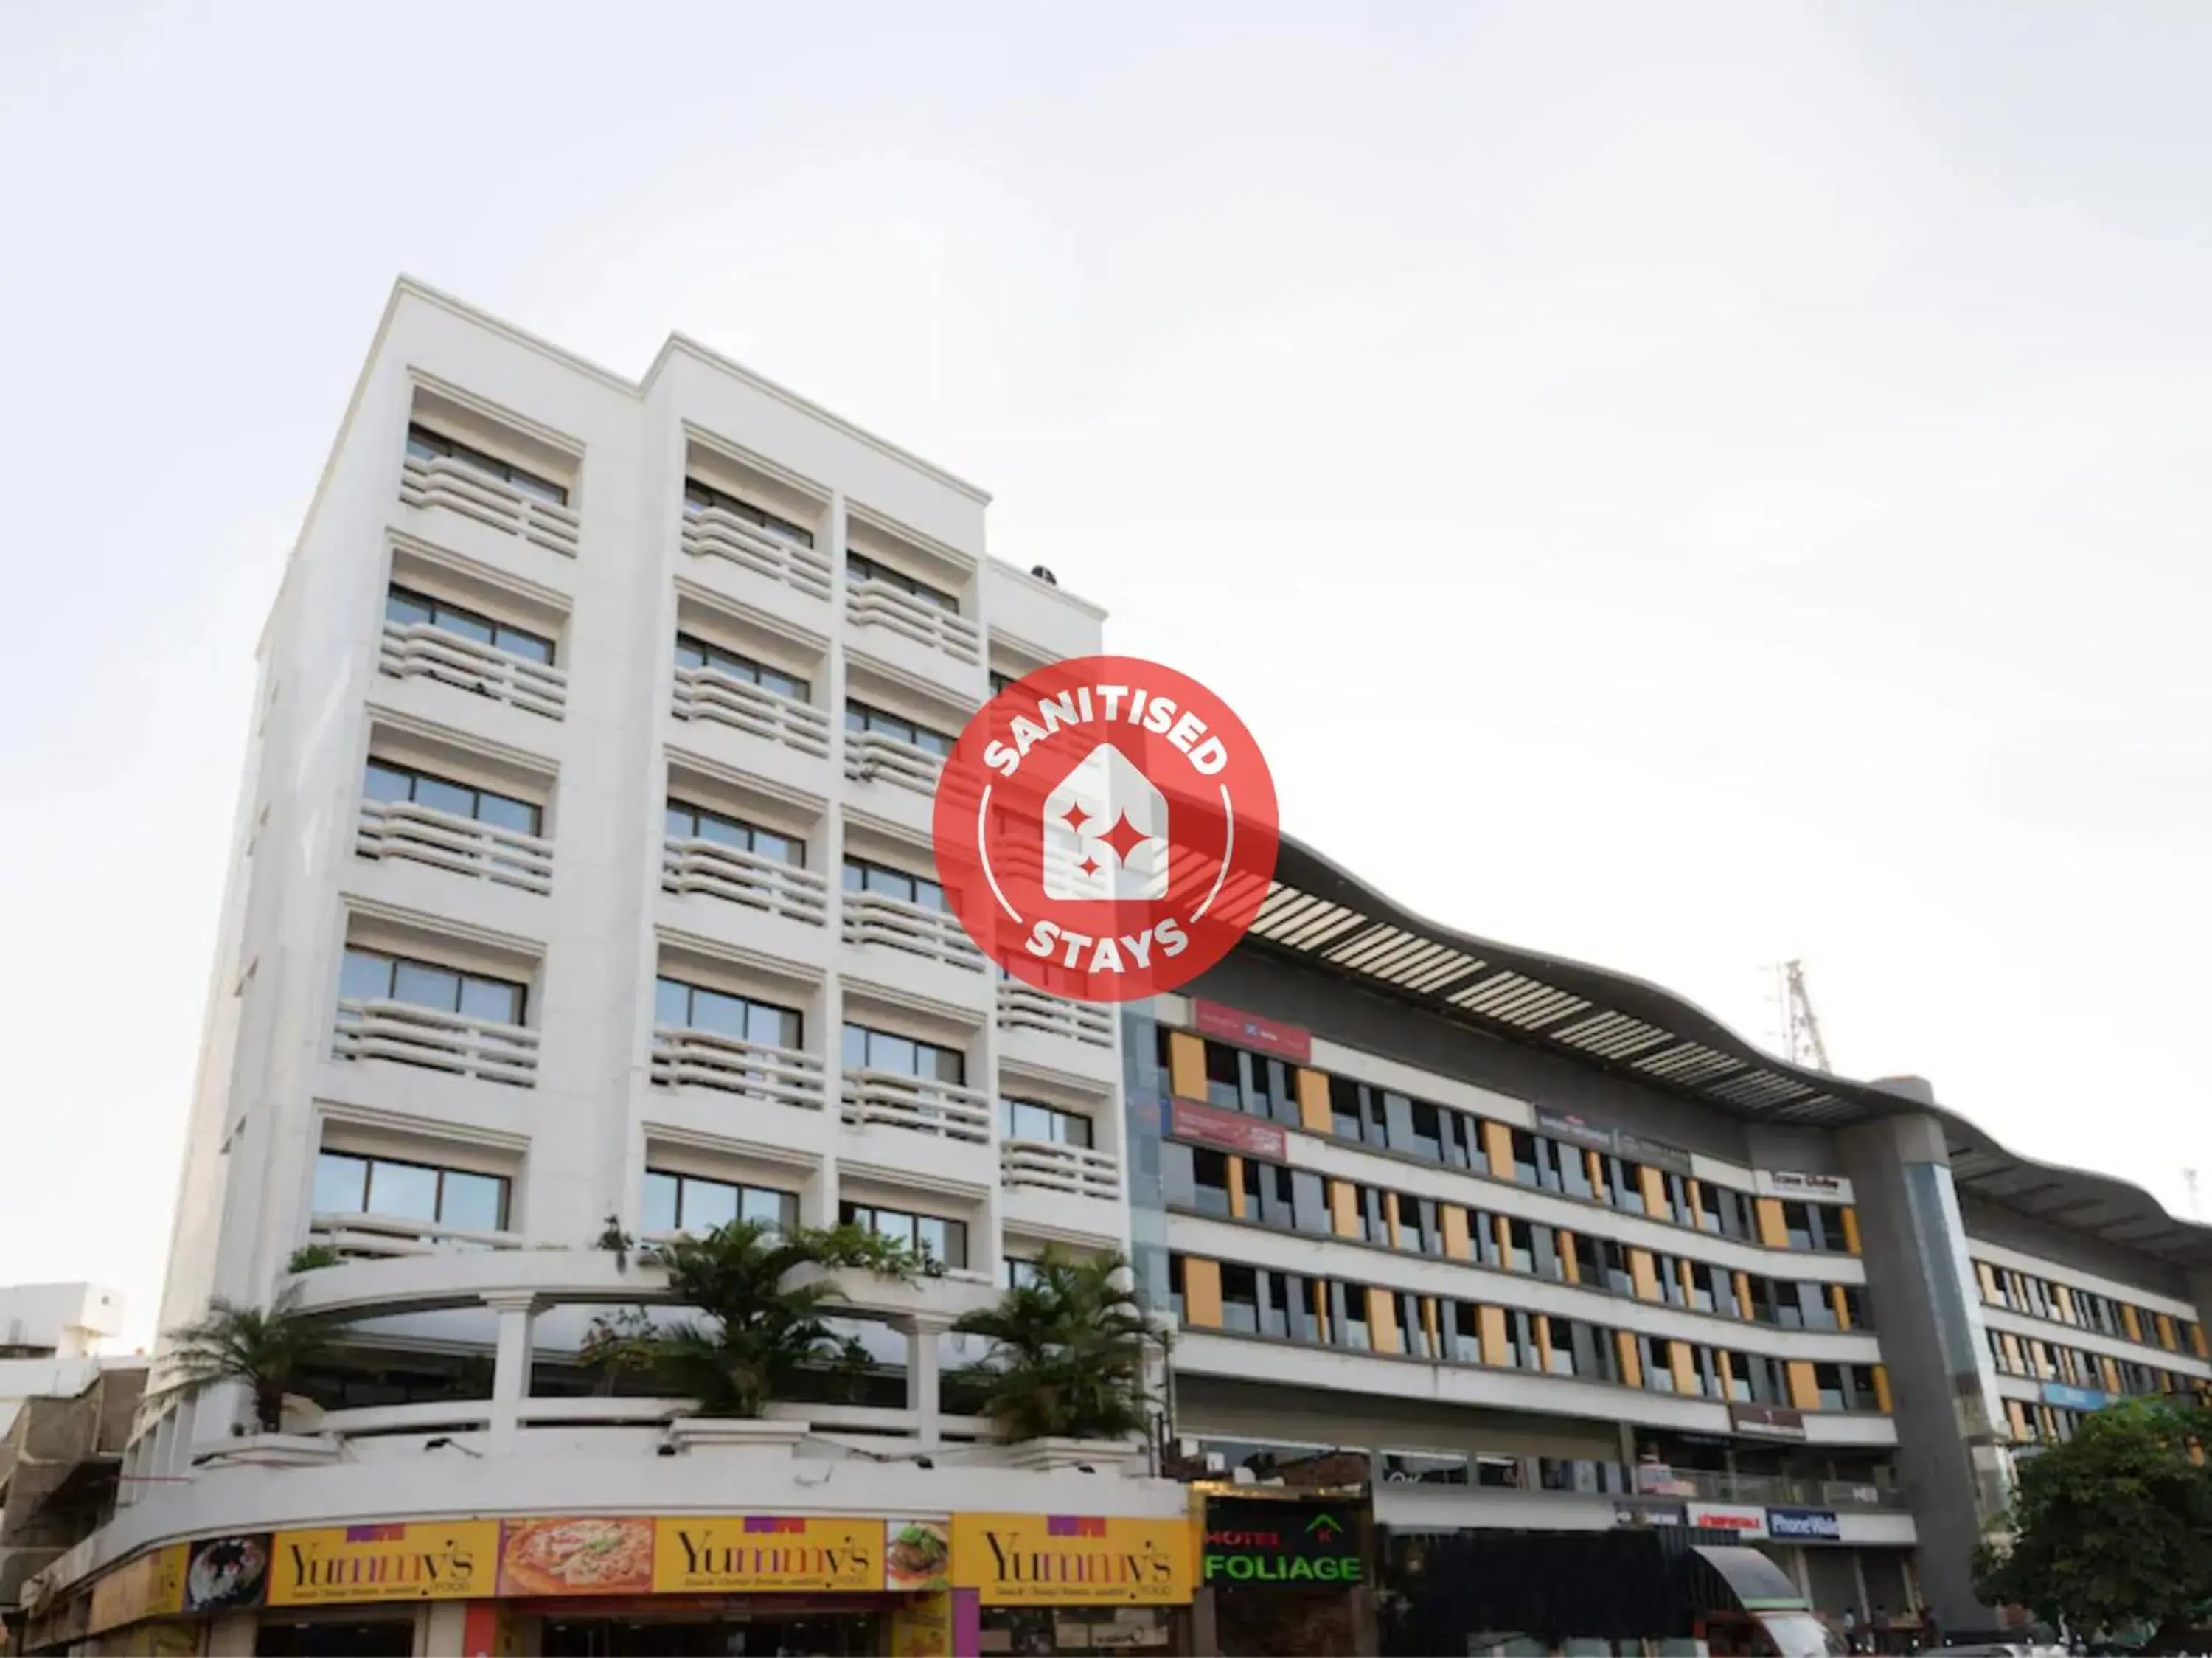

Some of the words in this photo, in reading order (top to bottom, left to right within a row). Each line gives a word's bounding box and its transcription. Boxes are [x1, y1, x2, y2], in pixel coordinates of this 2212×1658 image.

[288, 1539, 473, 1595] Yummy's
[675, 1530, 869, 1589] Yummy's
[981, 1531, 1171, 1599] Yummy's
[1205, 1555, 1363, 1580] FOLIAGE
